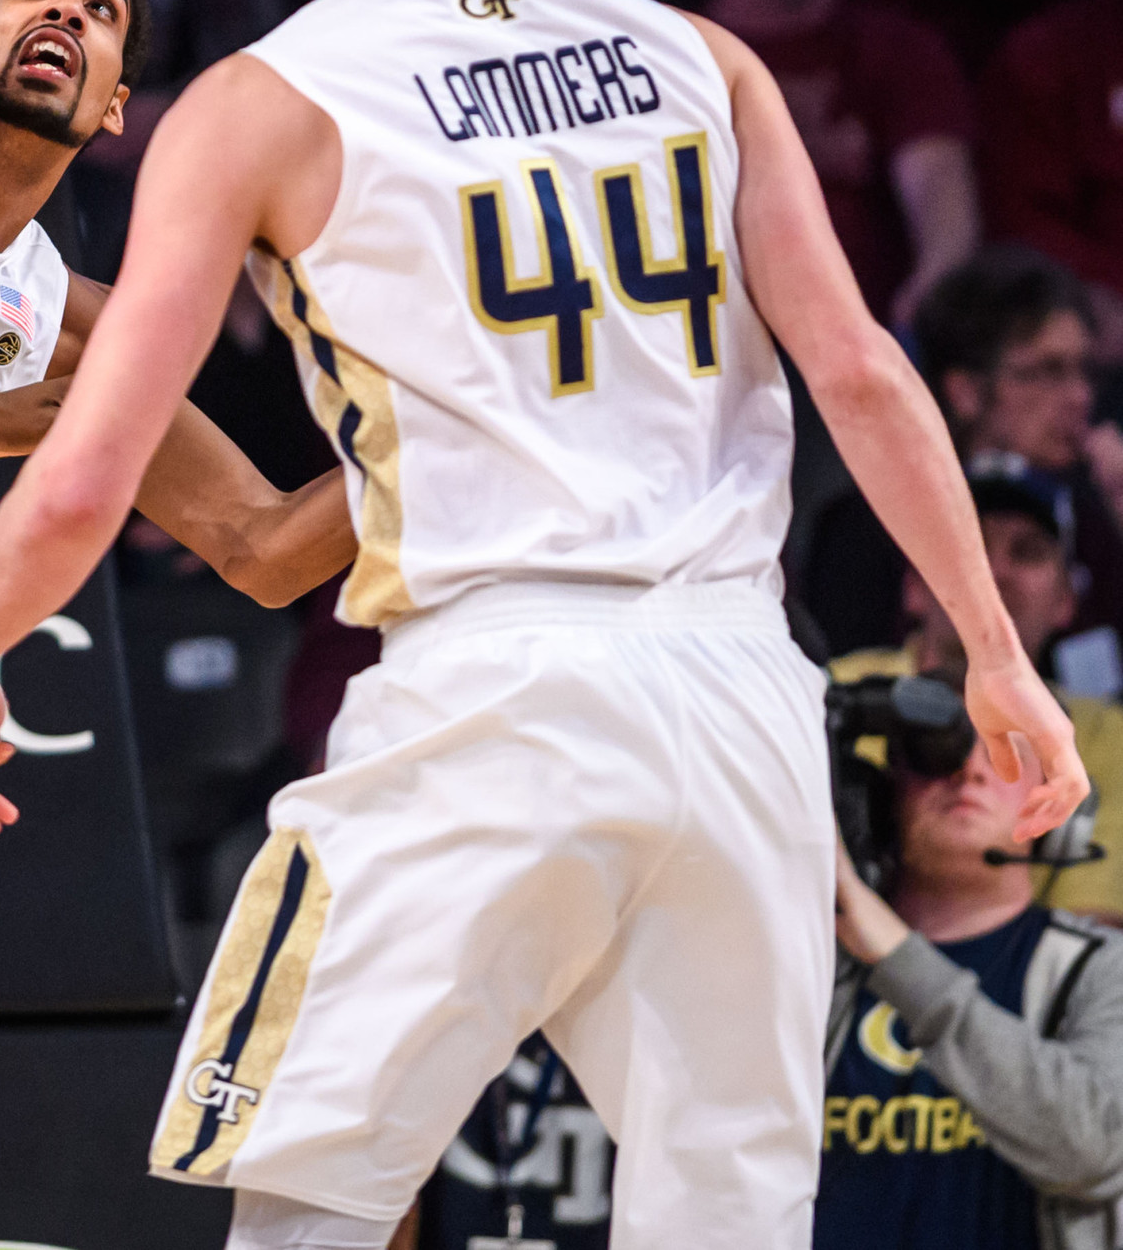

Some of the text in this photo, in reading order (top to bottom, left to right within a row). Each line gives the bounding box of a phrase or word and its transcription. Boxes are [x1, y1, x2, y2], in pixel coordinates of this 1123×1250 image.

[414, 35, 661, 142] LAMMERS
[458, 131, 727, 399] 44
[184, 1057, 261, 1126] GT
[823, 1093, 987, 1154] FOOTBA
